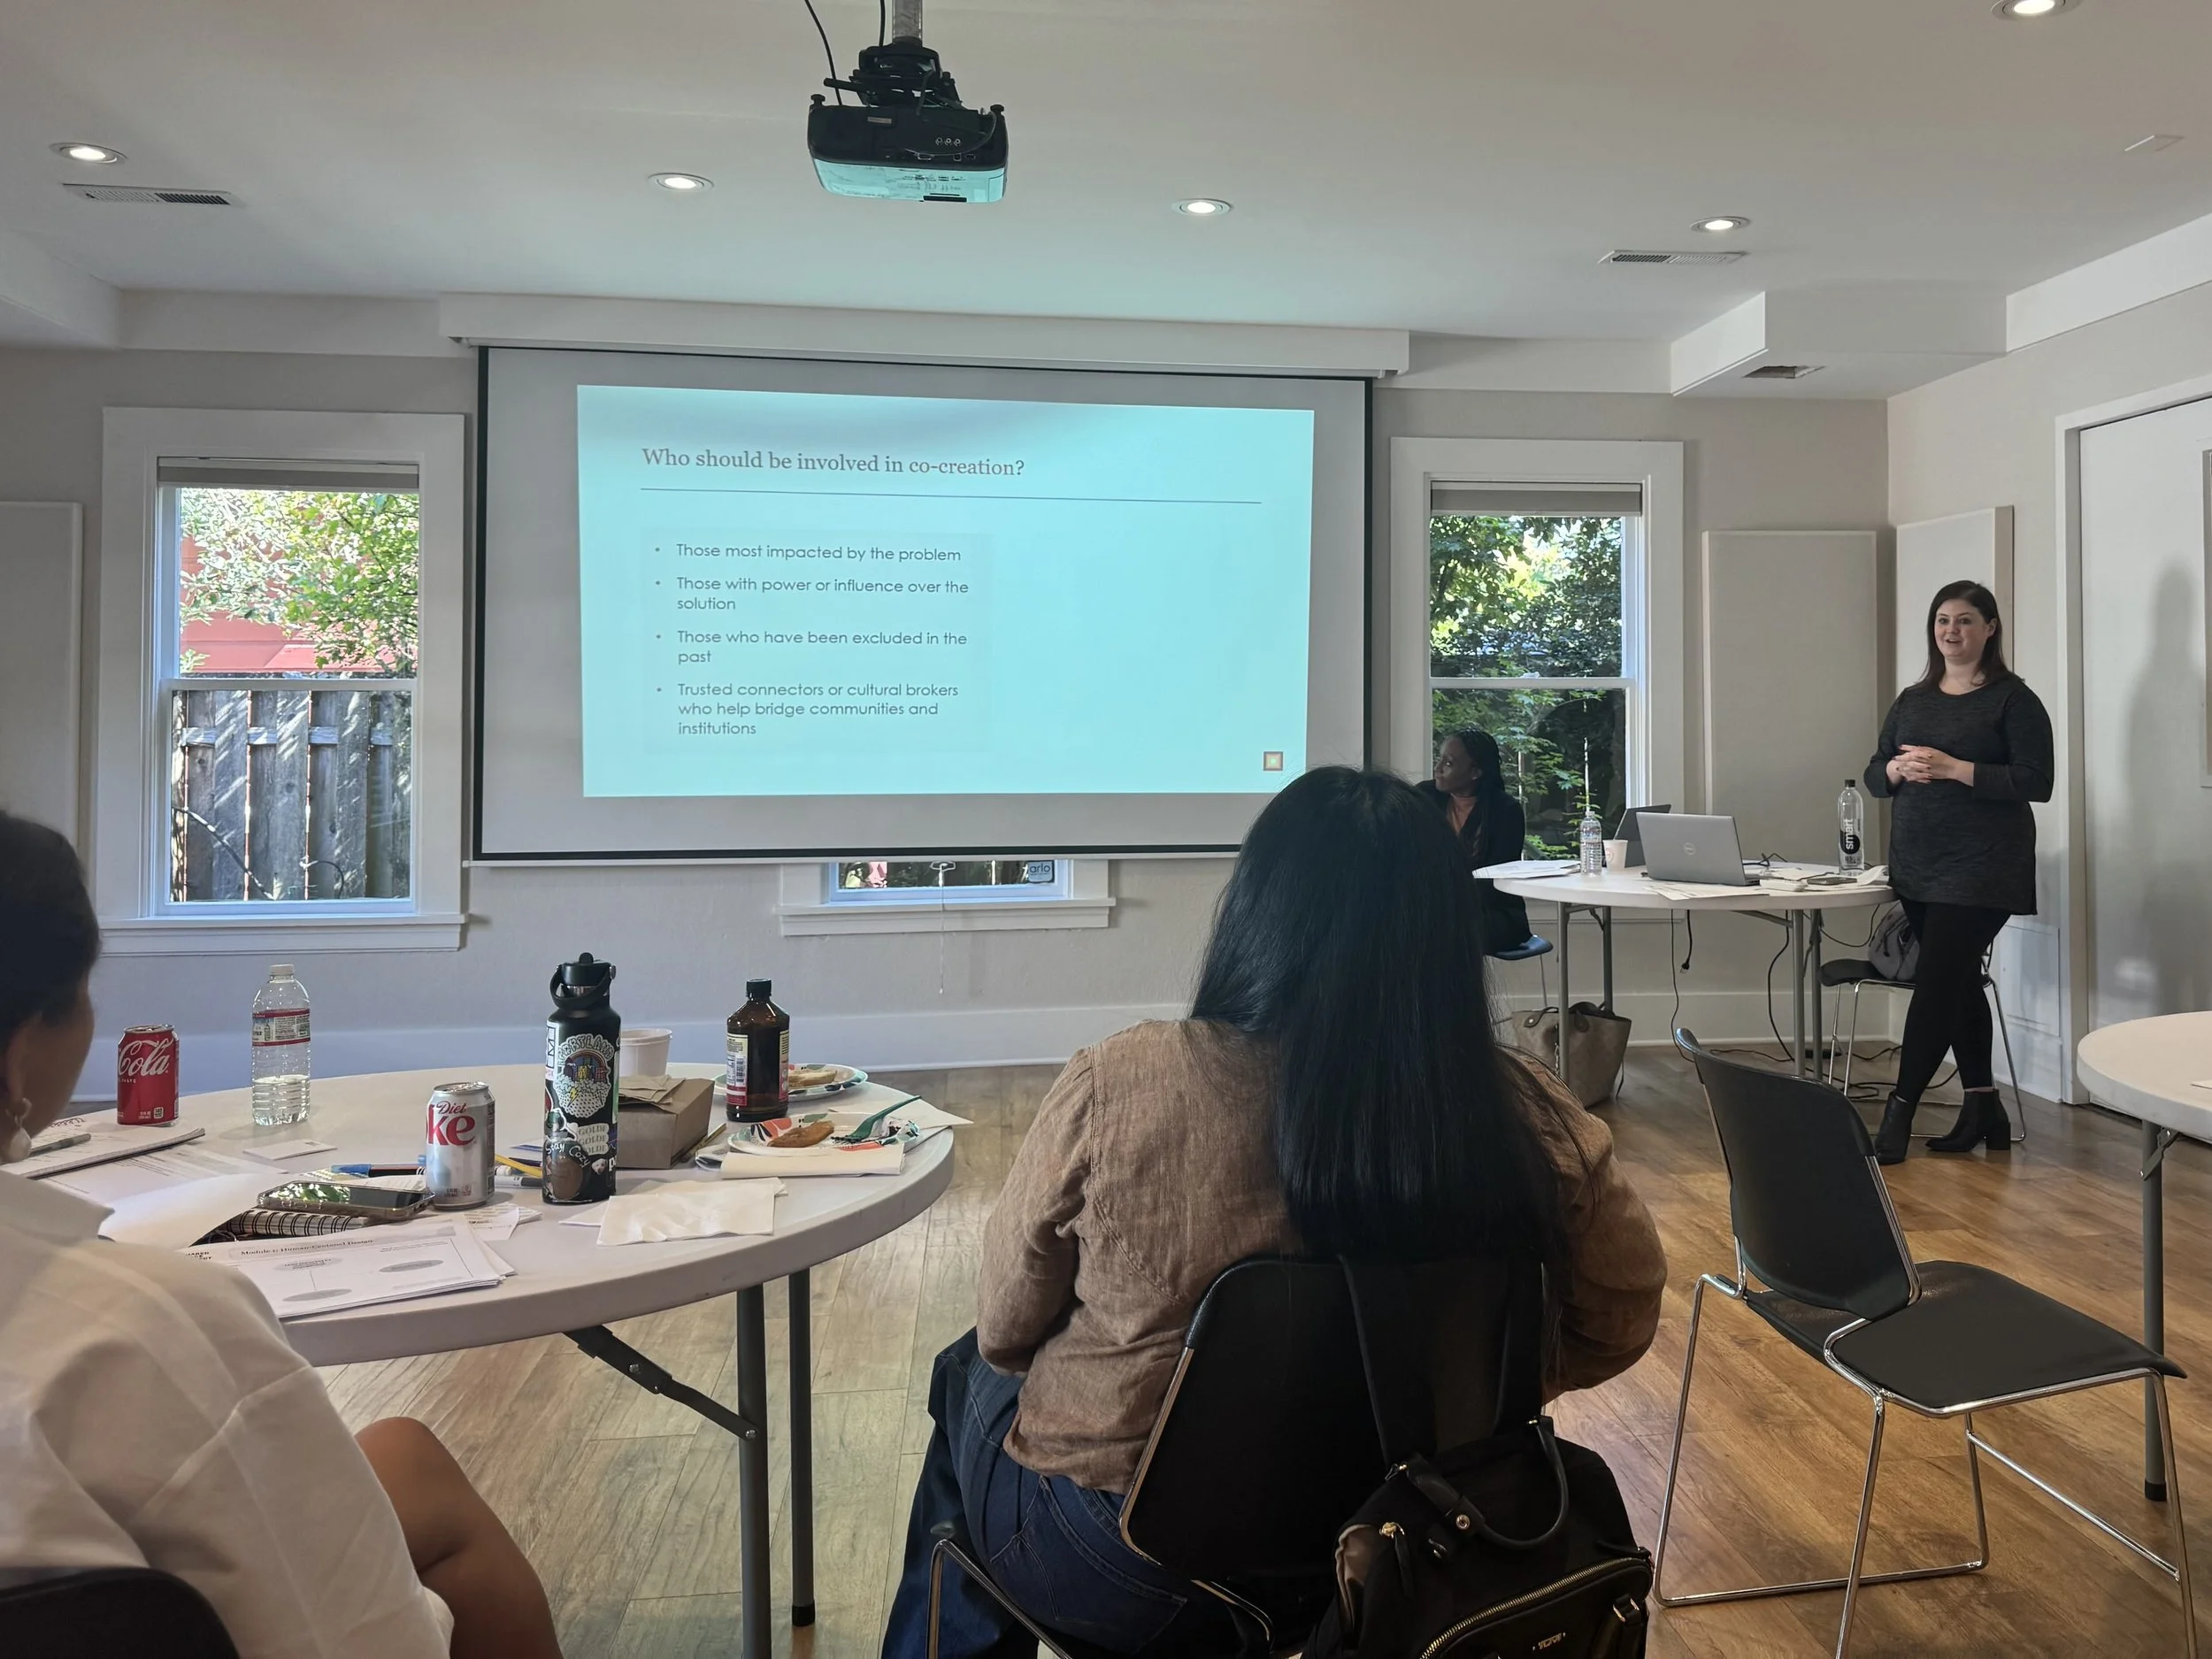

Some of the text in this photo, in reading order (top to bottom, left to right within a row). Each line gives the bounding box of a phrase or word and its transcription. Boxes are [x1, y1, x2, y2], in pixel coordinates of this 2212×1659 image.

[641, 448, 1025, 476] Who should be involved in co-creation?
[676, 543, 961, 563] Those most impacted by the problem
[677, 577, 969, 593] Those with power or influence over the
[677, 596, 736, 610] solution
[678, 630, 967, 645] Those who have been excluded in the
[678, 650, 711, 665] past
[678, 683, 958, 696] Trusted connectors or cultural brokers
[678, 703, 938, 718] who help bridge communities and
[679, 722, 757, 735] institutions
[1843, 817, 1855, 850] smart
[1029, 863, 1051, 873] arlo
[436, 1100, 468, 1115] Diet
[426, 1103, 476, 1146] ke
[569, 1145, 591, 1168] Cozy
